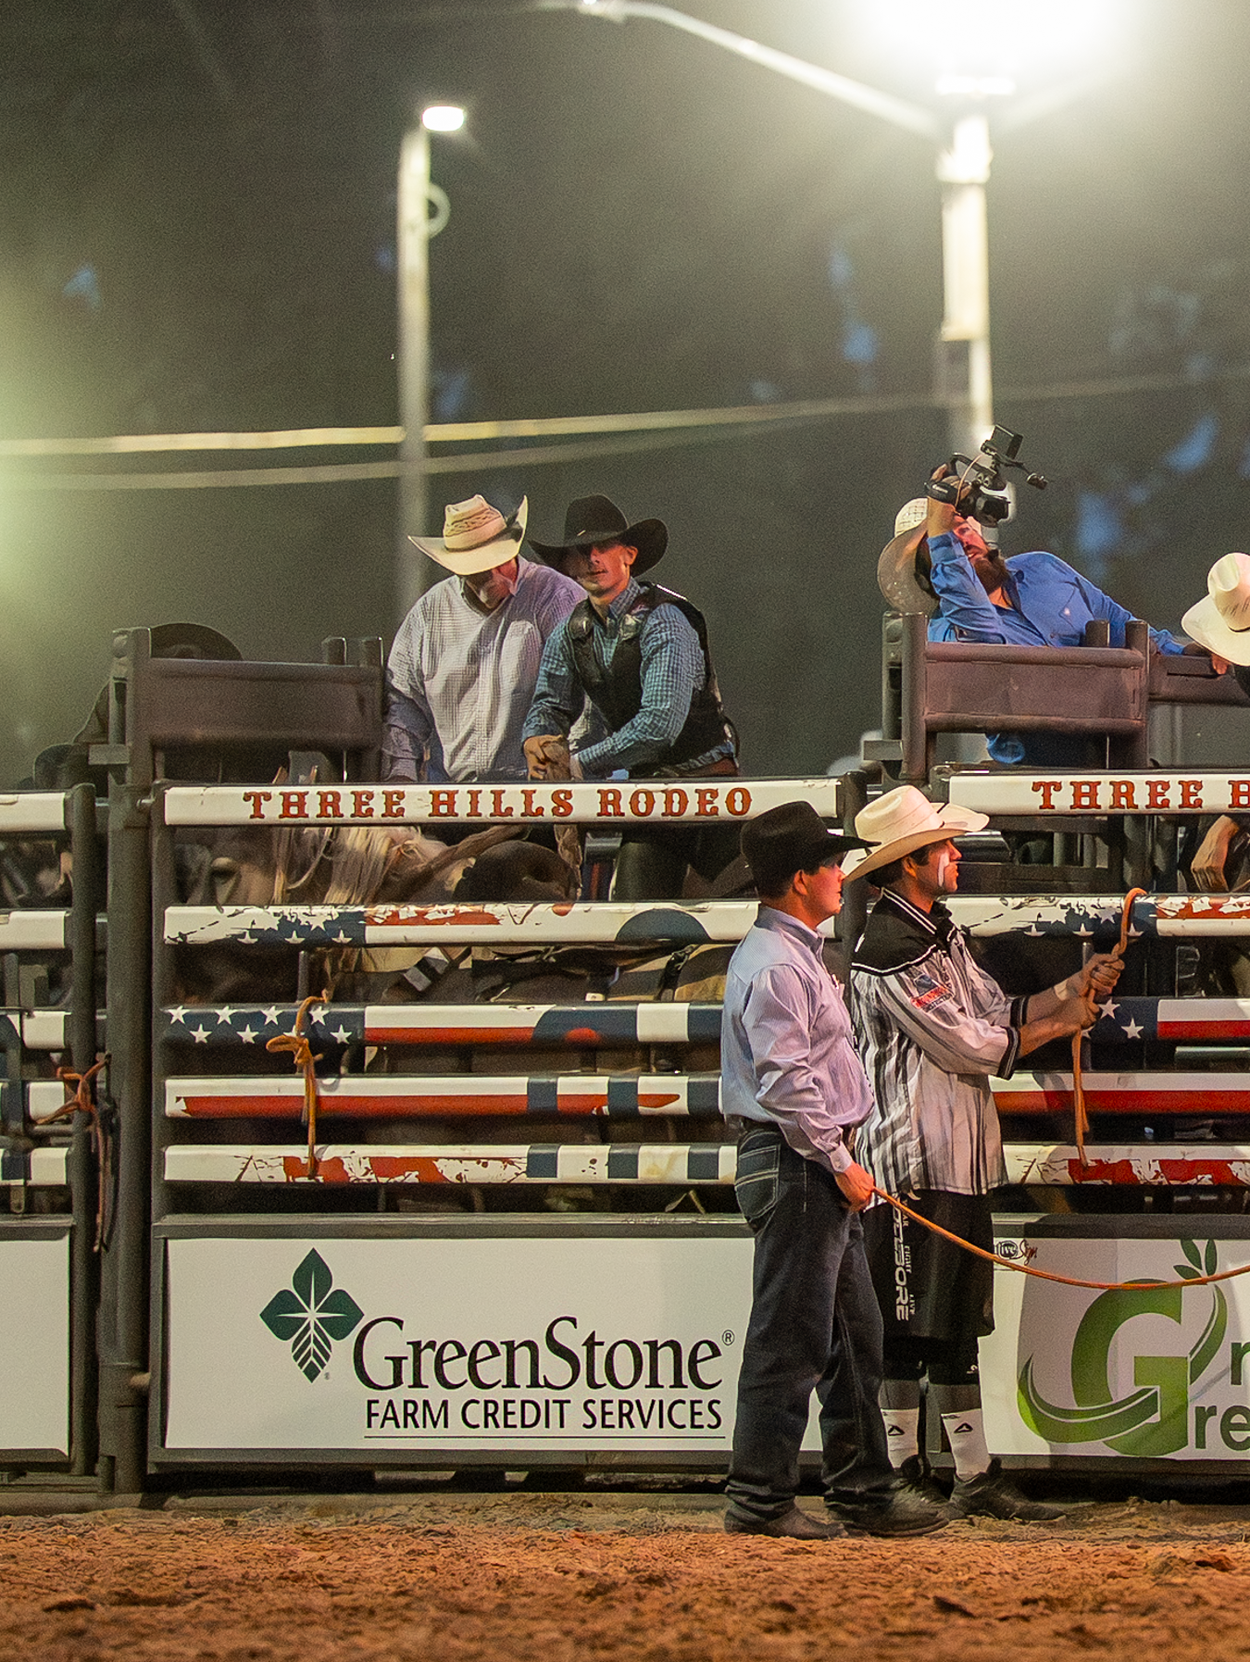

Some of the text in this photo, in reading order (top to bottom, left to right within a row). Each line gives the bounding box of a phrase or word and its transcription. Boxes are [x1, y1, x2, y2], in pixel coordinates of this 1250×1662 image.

[243, 788, 752, 819] THREE HILLS RODEO
[1032, 780, 1203, 810] THREE
[366, 1398, 722, 1430] FARM CREDIT SERVICES
